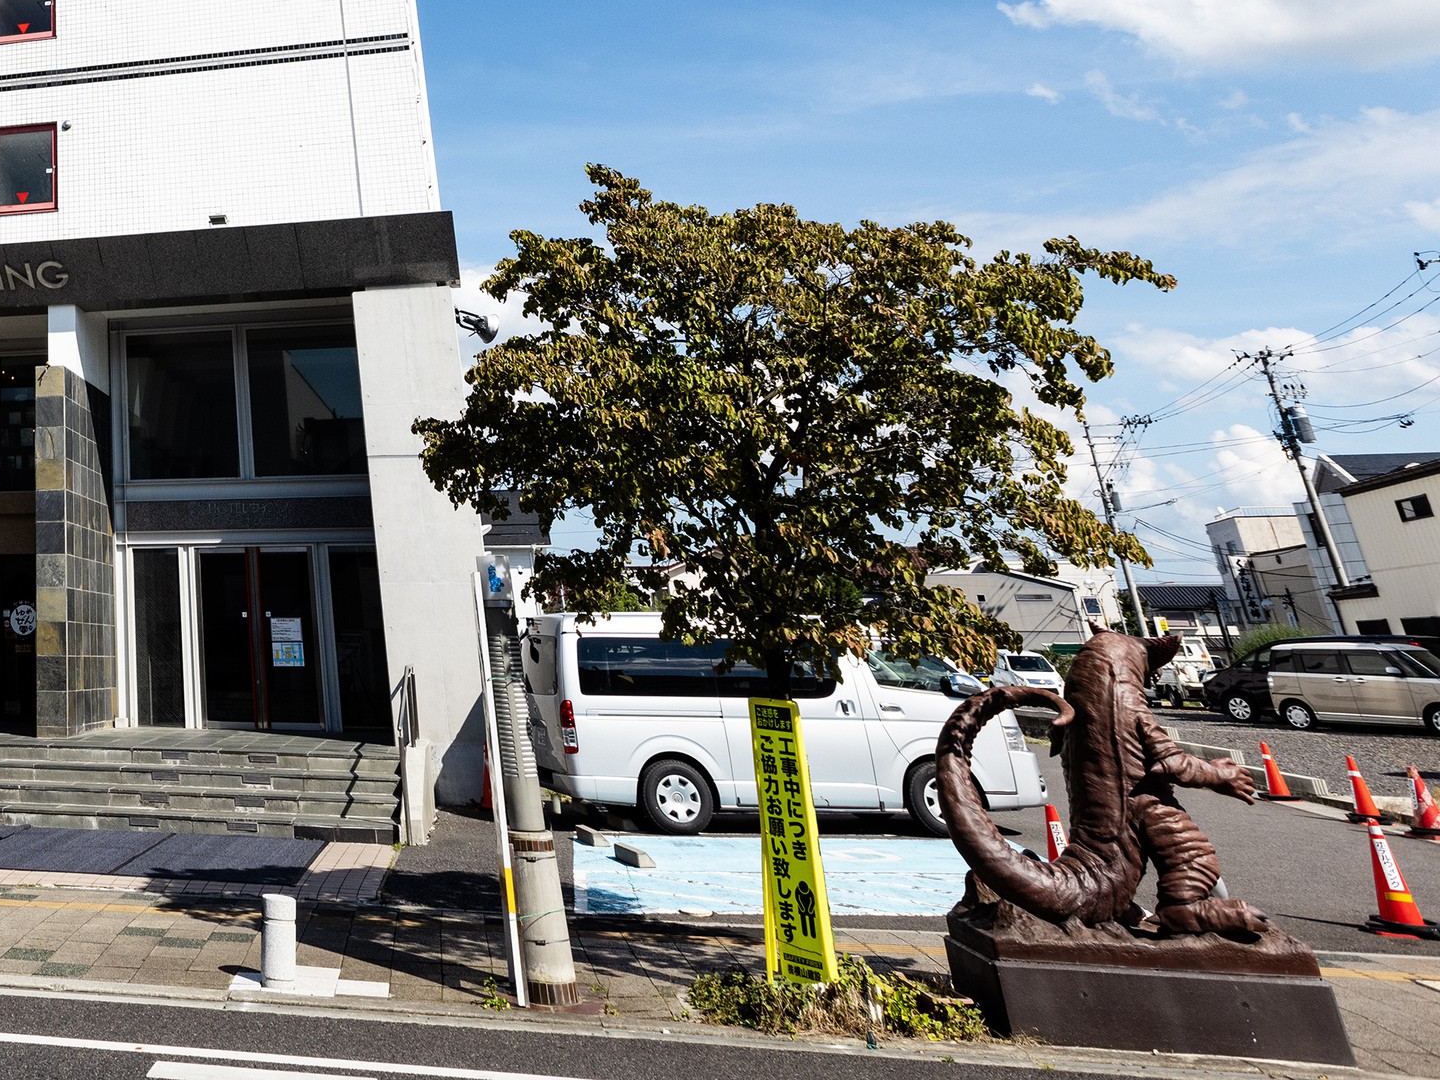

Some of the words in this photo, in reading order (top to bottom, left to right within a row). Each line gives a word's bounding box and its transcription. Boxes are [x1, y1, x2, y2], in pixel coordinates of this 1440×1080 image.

[760, 735, 797, 943] ご協力お願い致します
[778, 737, 807, 861] 工事中につき
